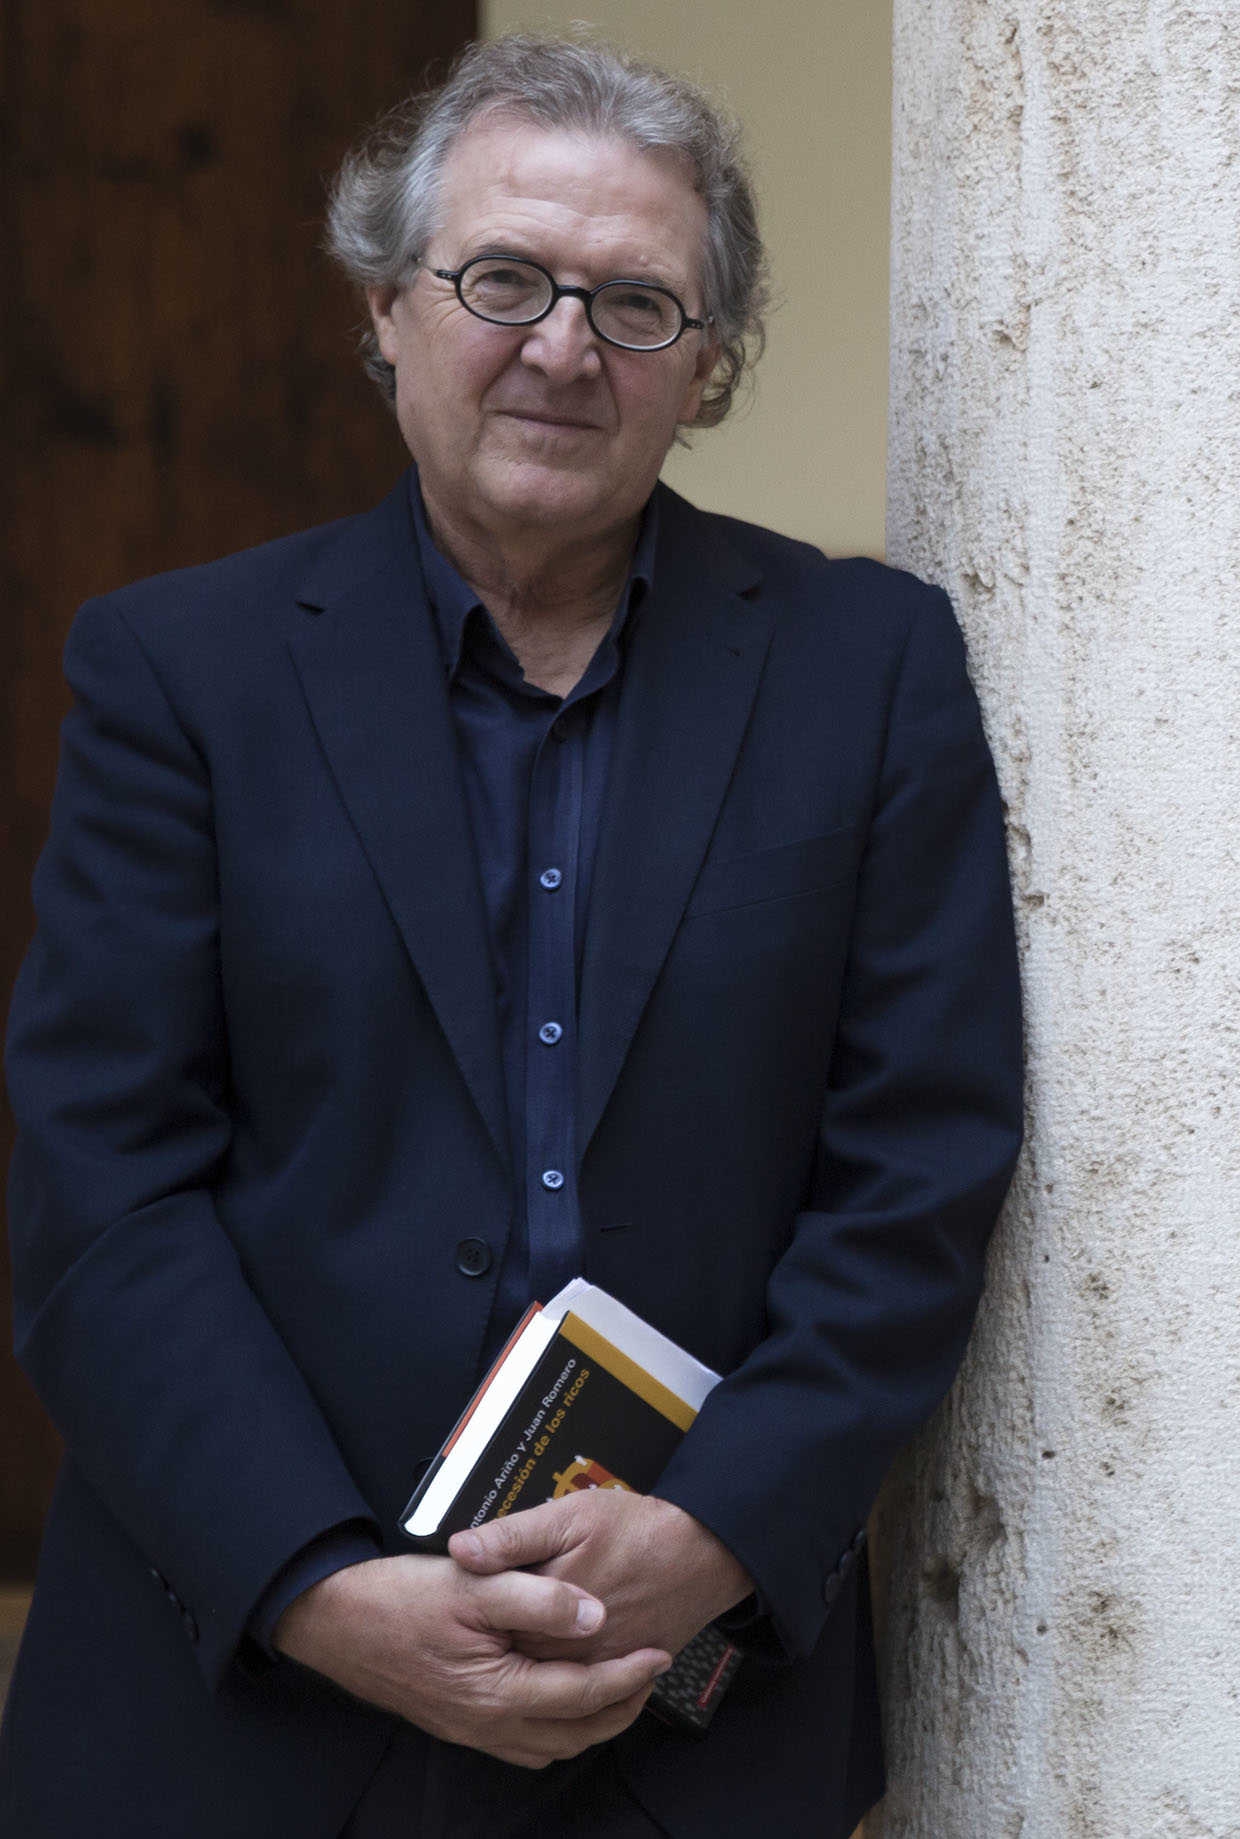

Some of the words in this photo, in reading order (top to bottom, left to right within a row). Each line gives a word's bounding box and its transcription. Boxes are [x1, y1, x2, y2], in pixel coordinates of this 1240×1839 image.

[470, 1489, 498, 1529] ntonio
[494, 1453, 520, 1489] Ariño
[516, 1441, 527, 1453] y
[523, 1409, 546, 1441] Juan
[542, 1359, 576, 1408] Romero
[495, 1458, 536, 1519] ecesión
[534, 1435, 551, 1456] de
[545, 1408, 566, 1434] los
[563, 1368, 590, 1407] ricos
